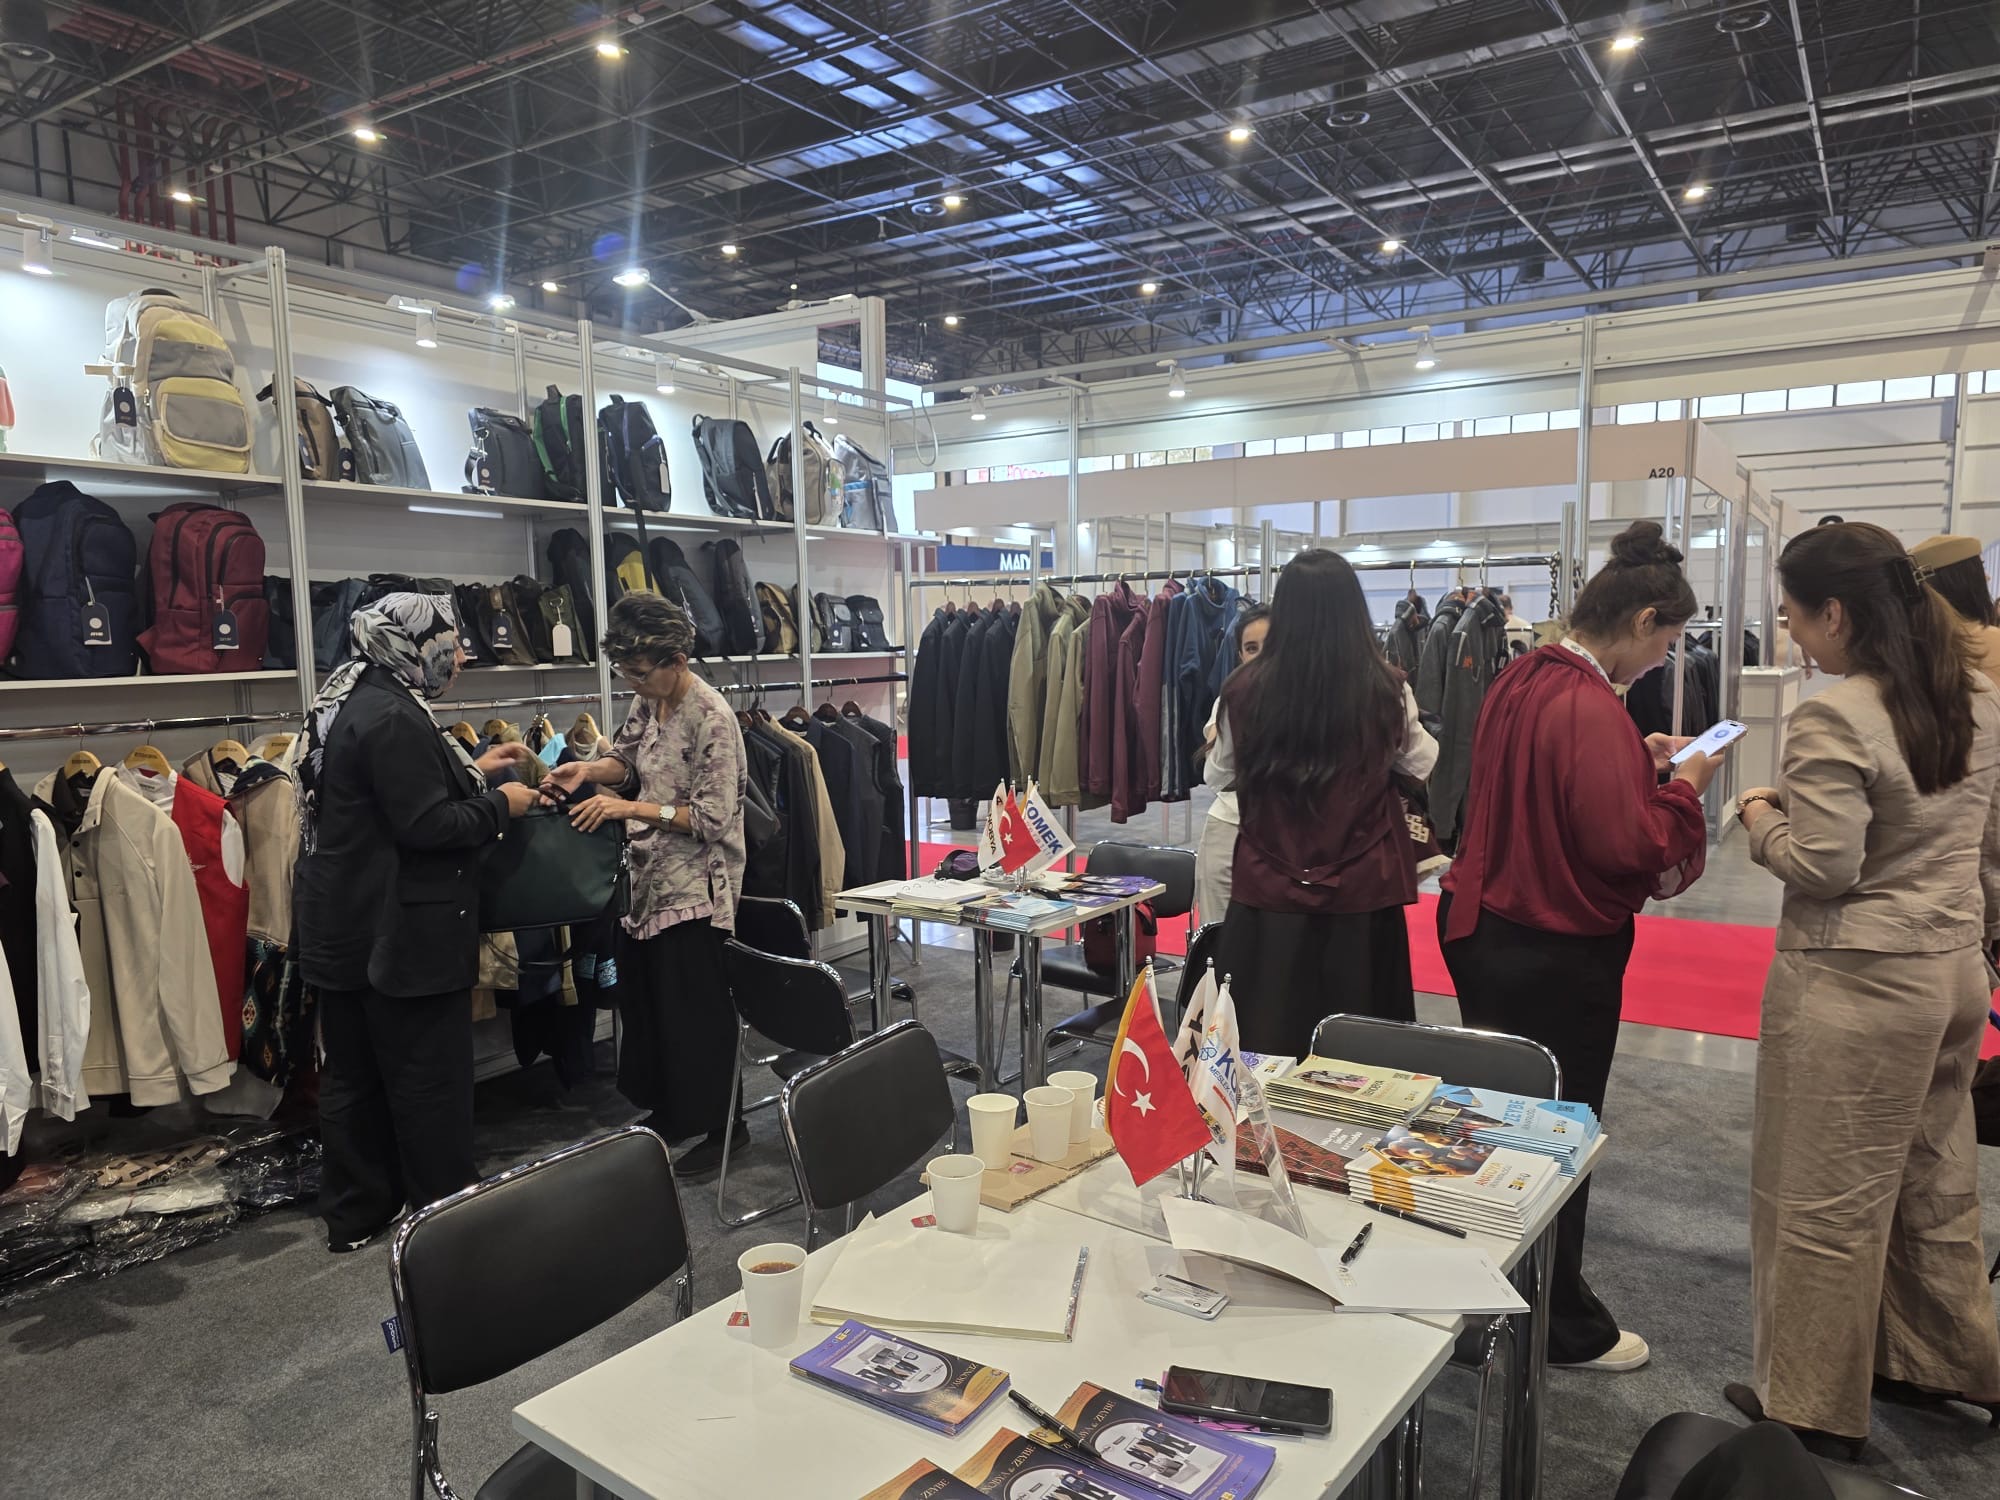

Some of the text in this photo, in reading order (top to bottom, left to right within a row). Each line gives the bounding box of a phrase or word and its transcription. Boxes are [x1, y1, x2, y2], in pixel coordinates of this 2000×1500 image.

[1649, 467, 1675, 479] A20
[1094, 1400, 1116, 1422] ZEYBE
[1011, 1446, 1036, 1468] ZEYBE
[920, 1478, 950, 1500] ZEYBE
